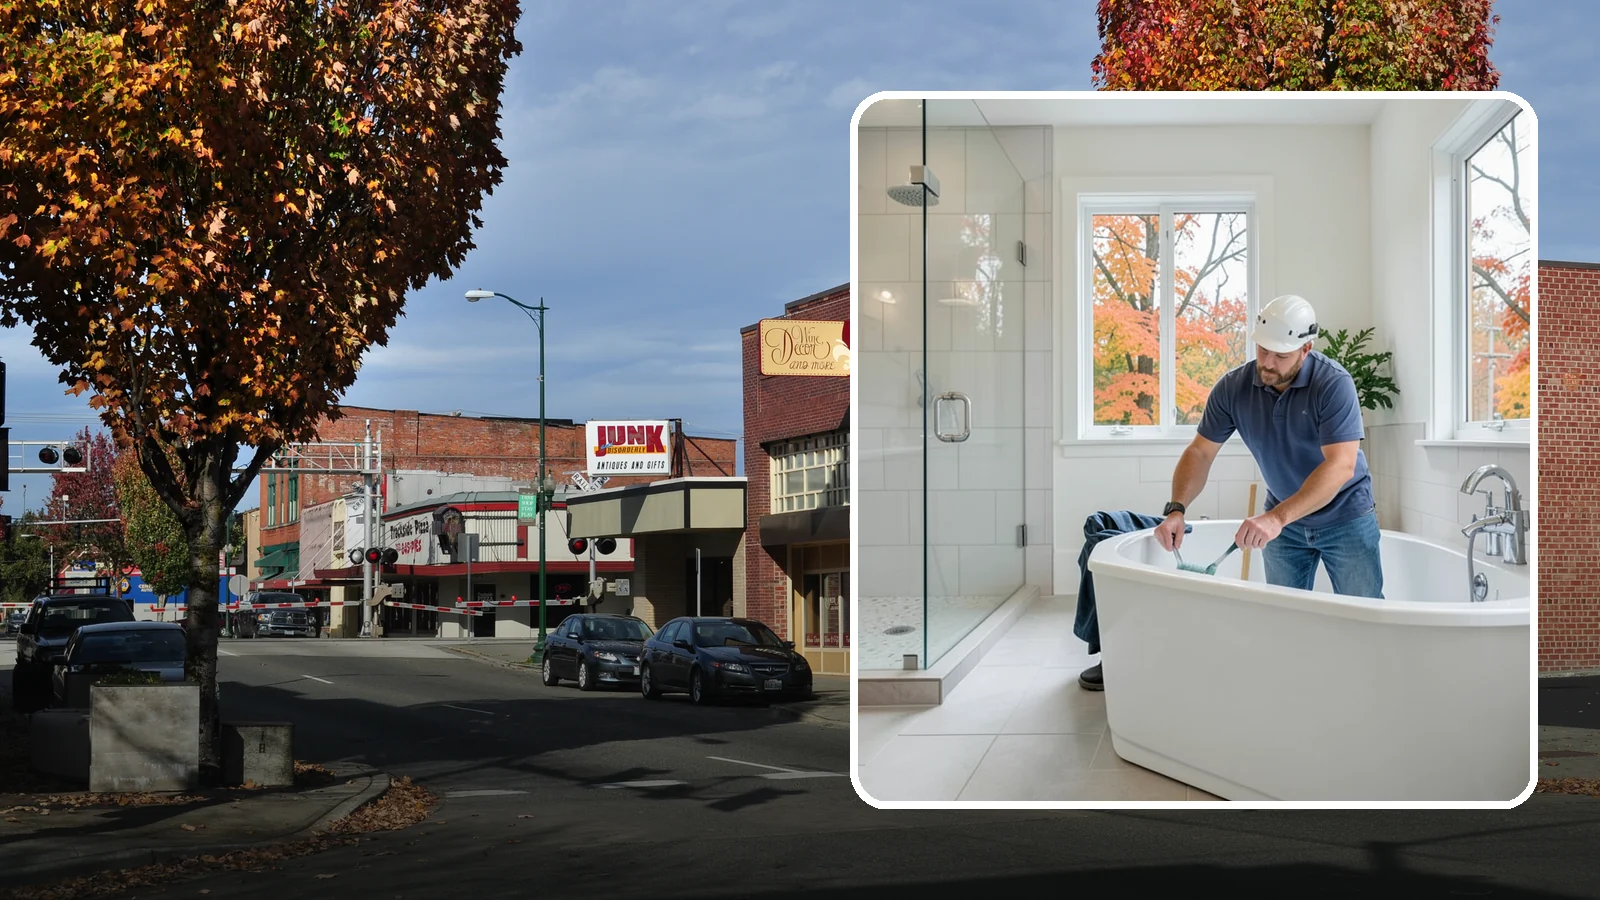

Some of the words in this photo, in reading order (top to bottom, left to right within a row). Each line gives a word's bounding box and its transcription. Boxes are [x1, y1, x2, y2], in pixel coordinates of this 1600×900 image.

[595, 425, 665, 457] JUNK
[607, 446, 646, 454] DISORDERLY
[597, 461, 628, 470] ANTIQUES
[631, 461, 644, 470] AND
[647, 460, 665, 469] GIFTS
[390, 521, 413, 540] Trackside
[414, 519, 429, 535] Pizza
